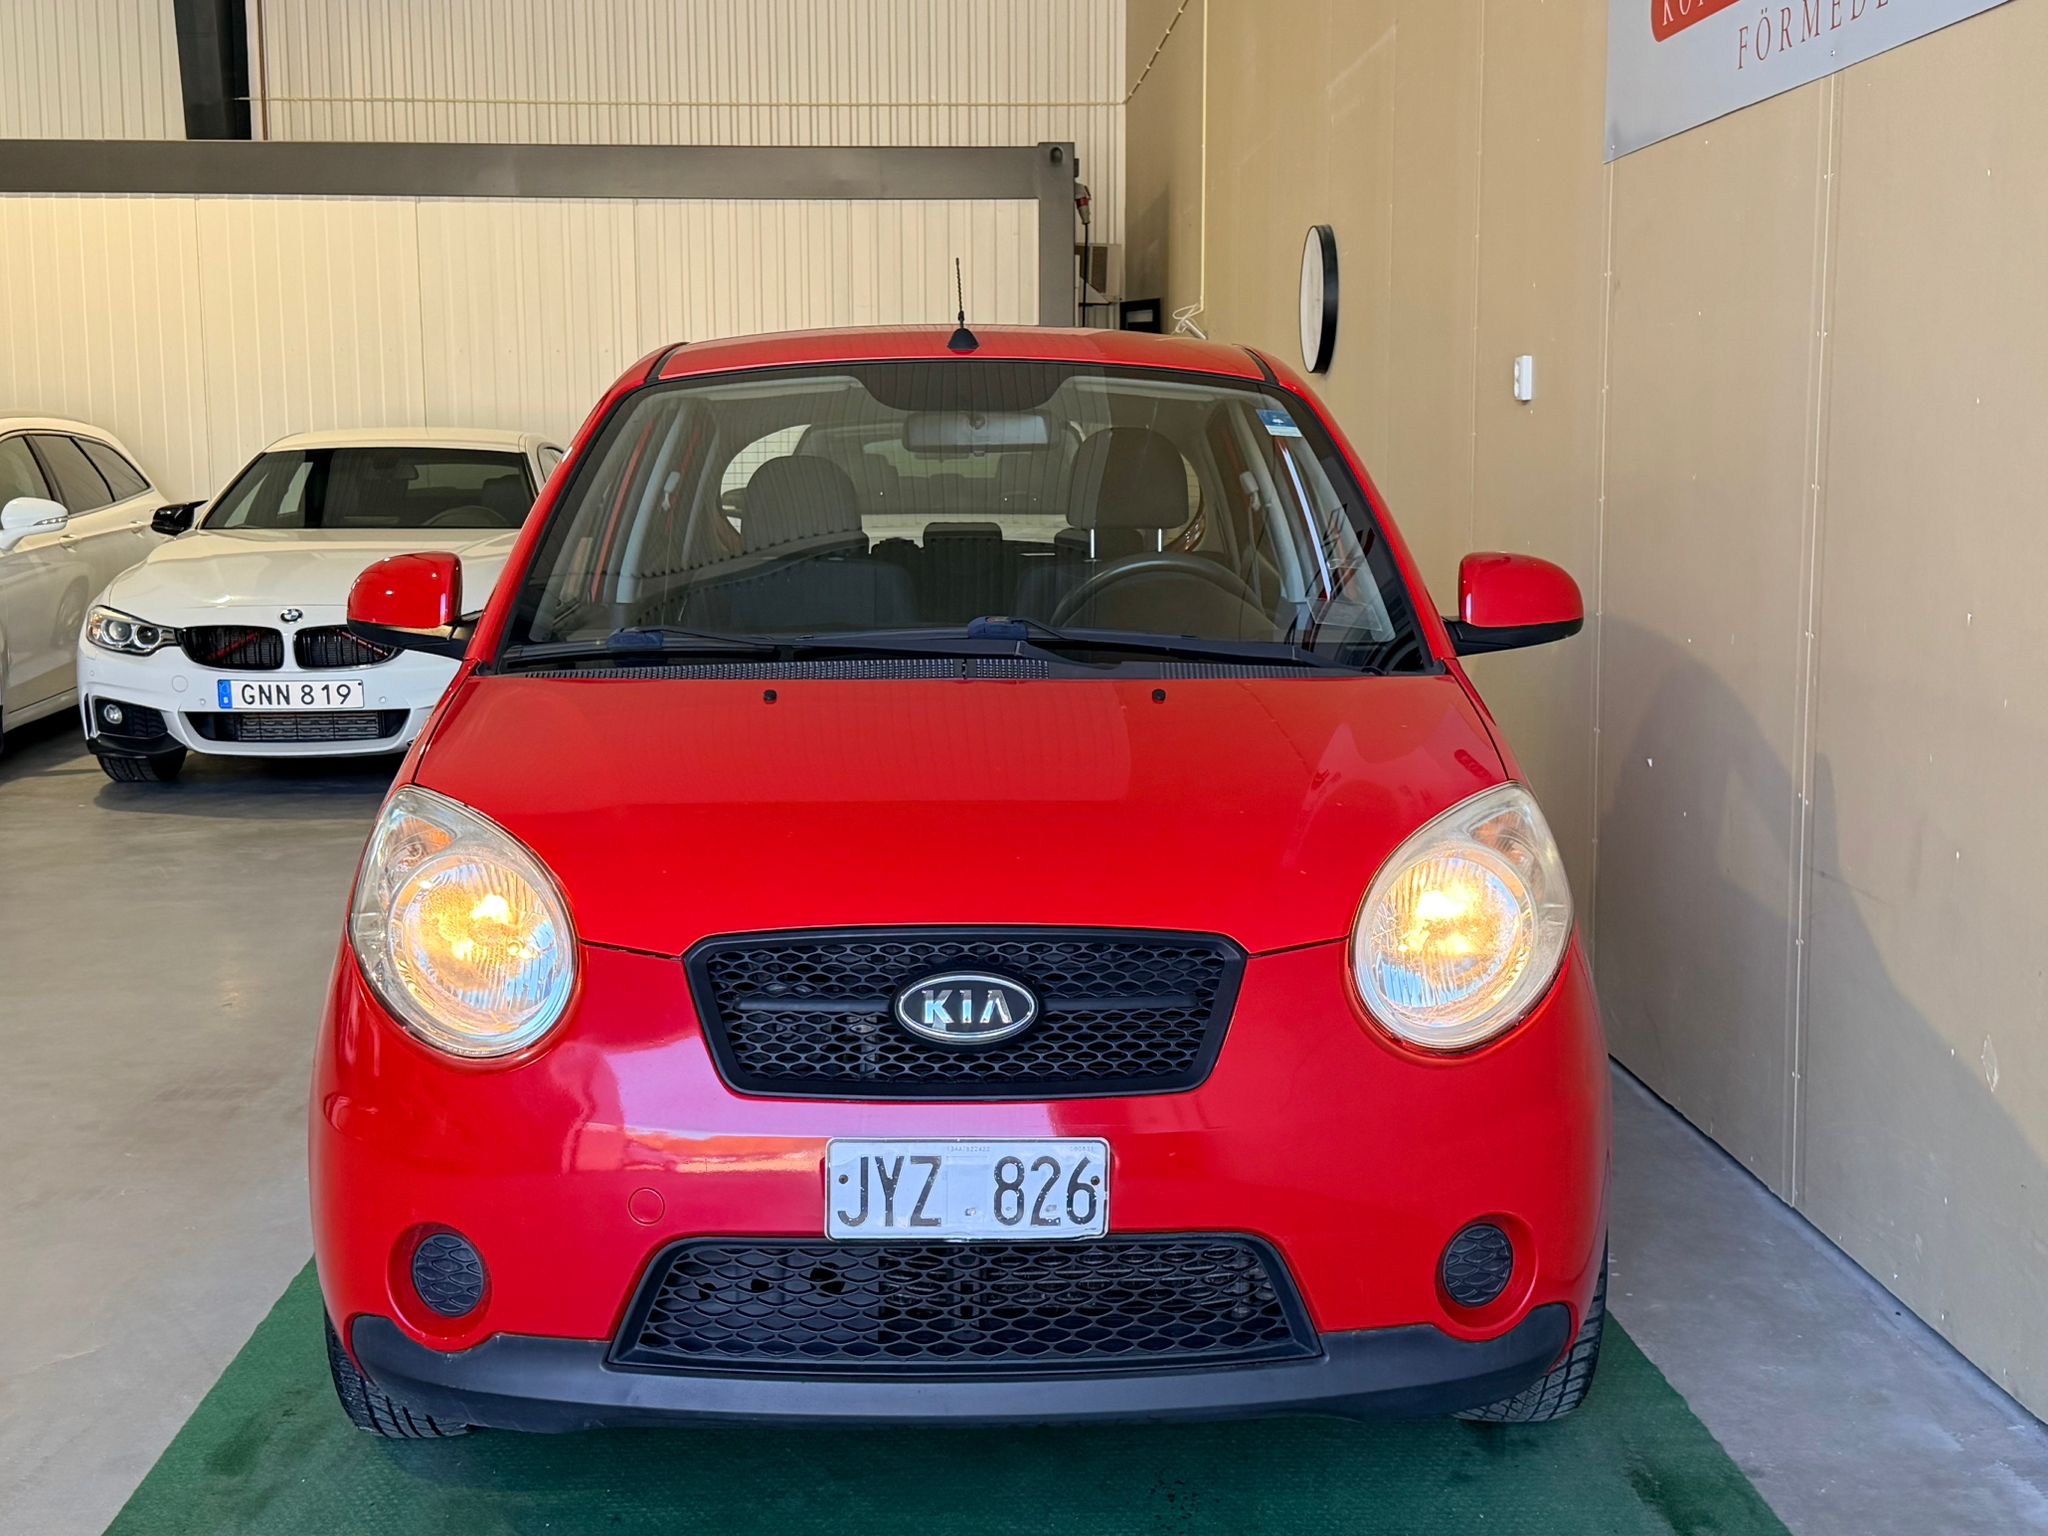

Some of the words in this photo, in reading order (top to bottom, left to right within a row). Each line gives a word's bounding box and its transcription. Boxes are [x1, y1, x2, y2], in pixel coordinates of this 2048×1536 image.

[1737, 0, 1889, 70] FÖRME
[241, 684, 291, 706] GNN
[301, 683, 352, 705] 819
[922, 989, 1013, 1024] KIA
[837, 1156, 942, 1227] JYZ
[993, 1155, 1097, 1226] 826
